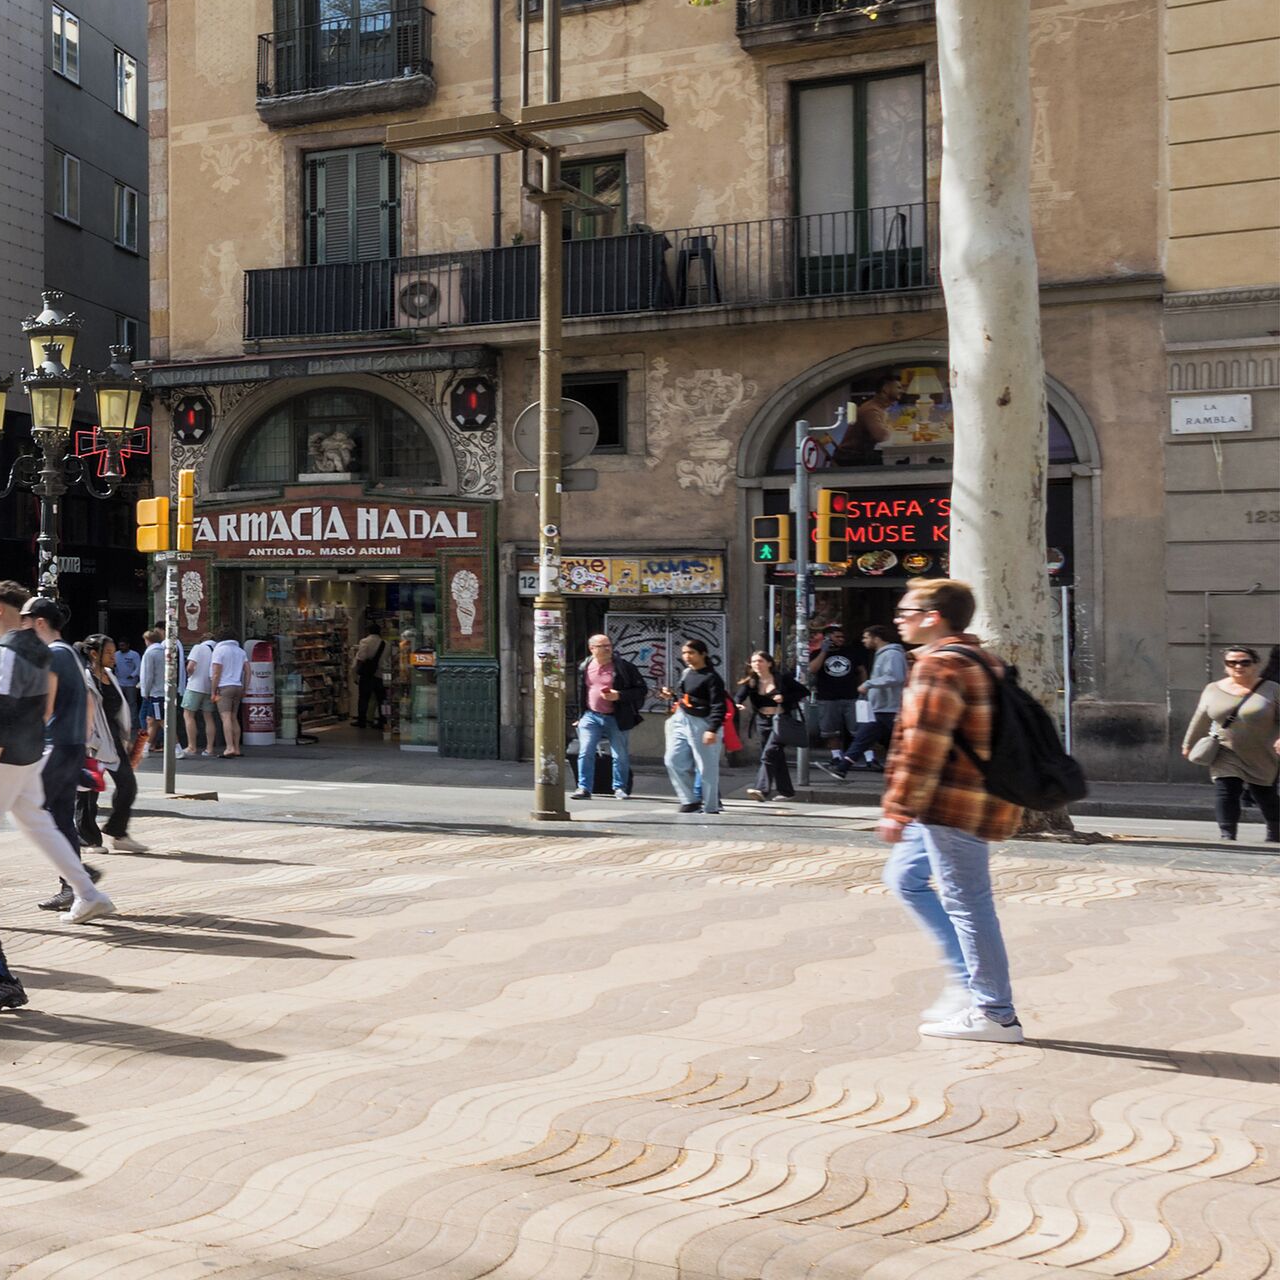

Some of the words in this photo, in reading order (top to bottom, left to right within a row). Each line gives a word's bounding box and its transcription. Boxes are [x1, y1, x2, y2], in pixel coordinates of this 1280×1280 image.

[1185, 416, 1237, 426] RAMBLA
[357, 507, 478, 540] NADAL
[1245, 510, 1280, 524] 123
[248, 546, 295, 557] ANTIGA
[319, 545, 357, 557] MASÓ
[359, 544, 402, 556] ARUMÍ
